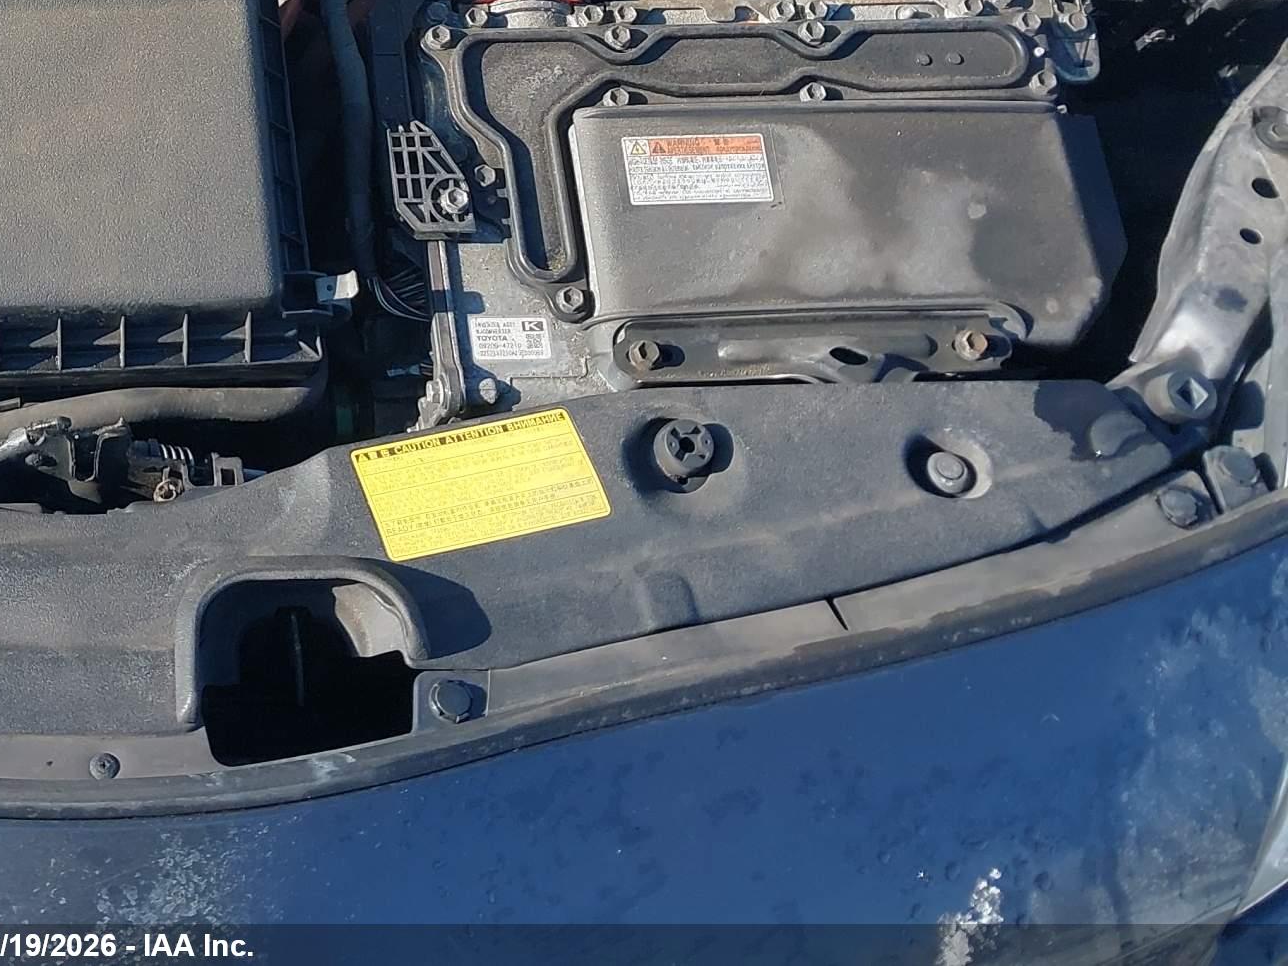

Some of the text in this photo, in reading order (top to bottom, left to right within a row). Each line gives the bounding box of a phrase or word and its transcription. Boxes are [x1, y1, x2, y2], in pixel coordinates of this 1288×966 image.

[395, 437, 440, 456] CAUTION
[445, 425, 503, 445] ATTENTION
[507, 412, 565, 432] ВНИМАНИЕ
